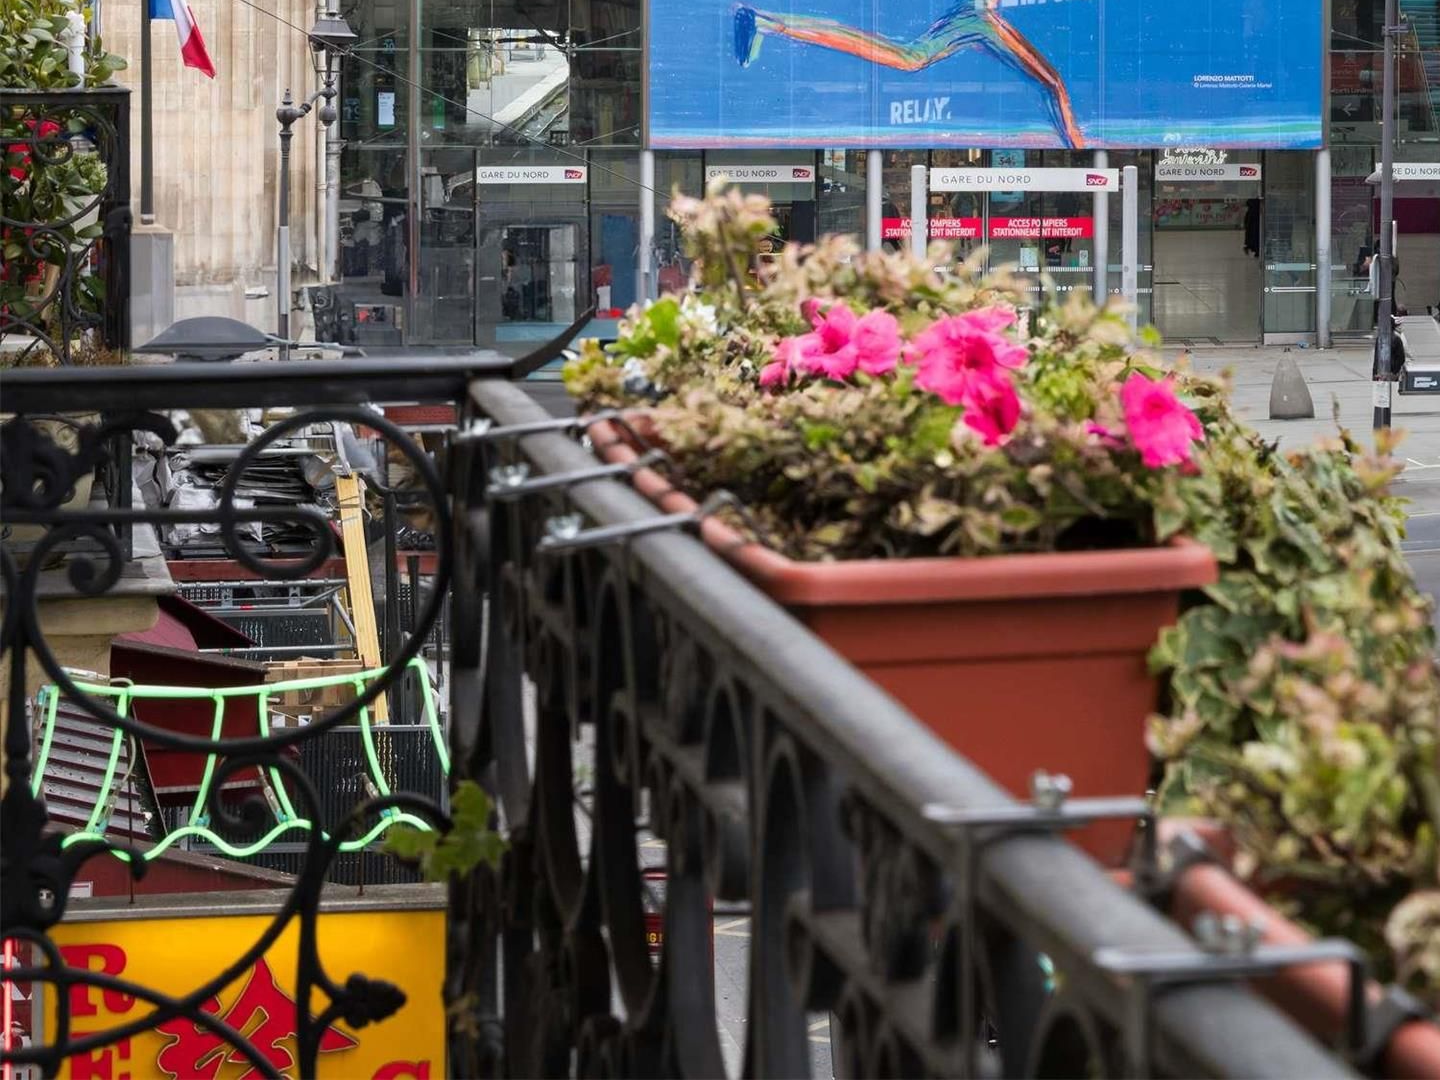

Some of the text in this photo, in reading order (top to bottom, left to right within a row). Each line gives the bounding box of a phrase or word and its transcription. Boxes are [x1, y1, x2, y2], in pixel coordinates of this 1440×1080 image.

[481, 171, 504, 179] GARE
[507, 171, 520, 179] DU
[523, 171, 549, 179] NORD
[736, 170, 749, 178] DU
[751, 170, 777, 178] NORD
[1159, 168, 1257, 176] GARE DU NORD SNCF
[1405, 167, 1417, 175] DU
[941, 175, 1108, 186] GARE DU NORD SNCF
[1008, 219, 1068, 227] ACCES POMPIERS
[945, 228, 976, 237] INTERDIT
[993, 228, 1082, 237] STATIONNEMENT INTERDIT
